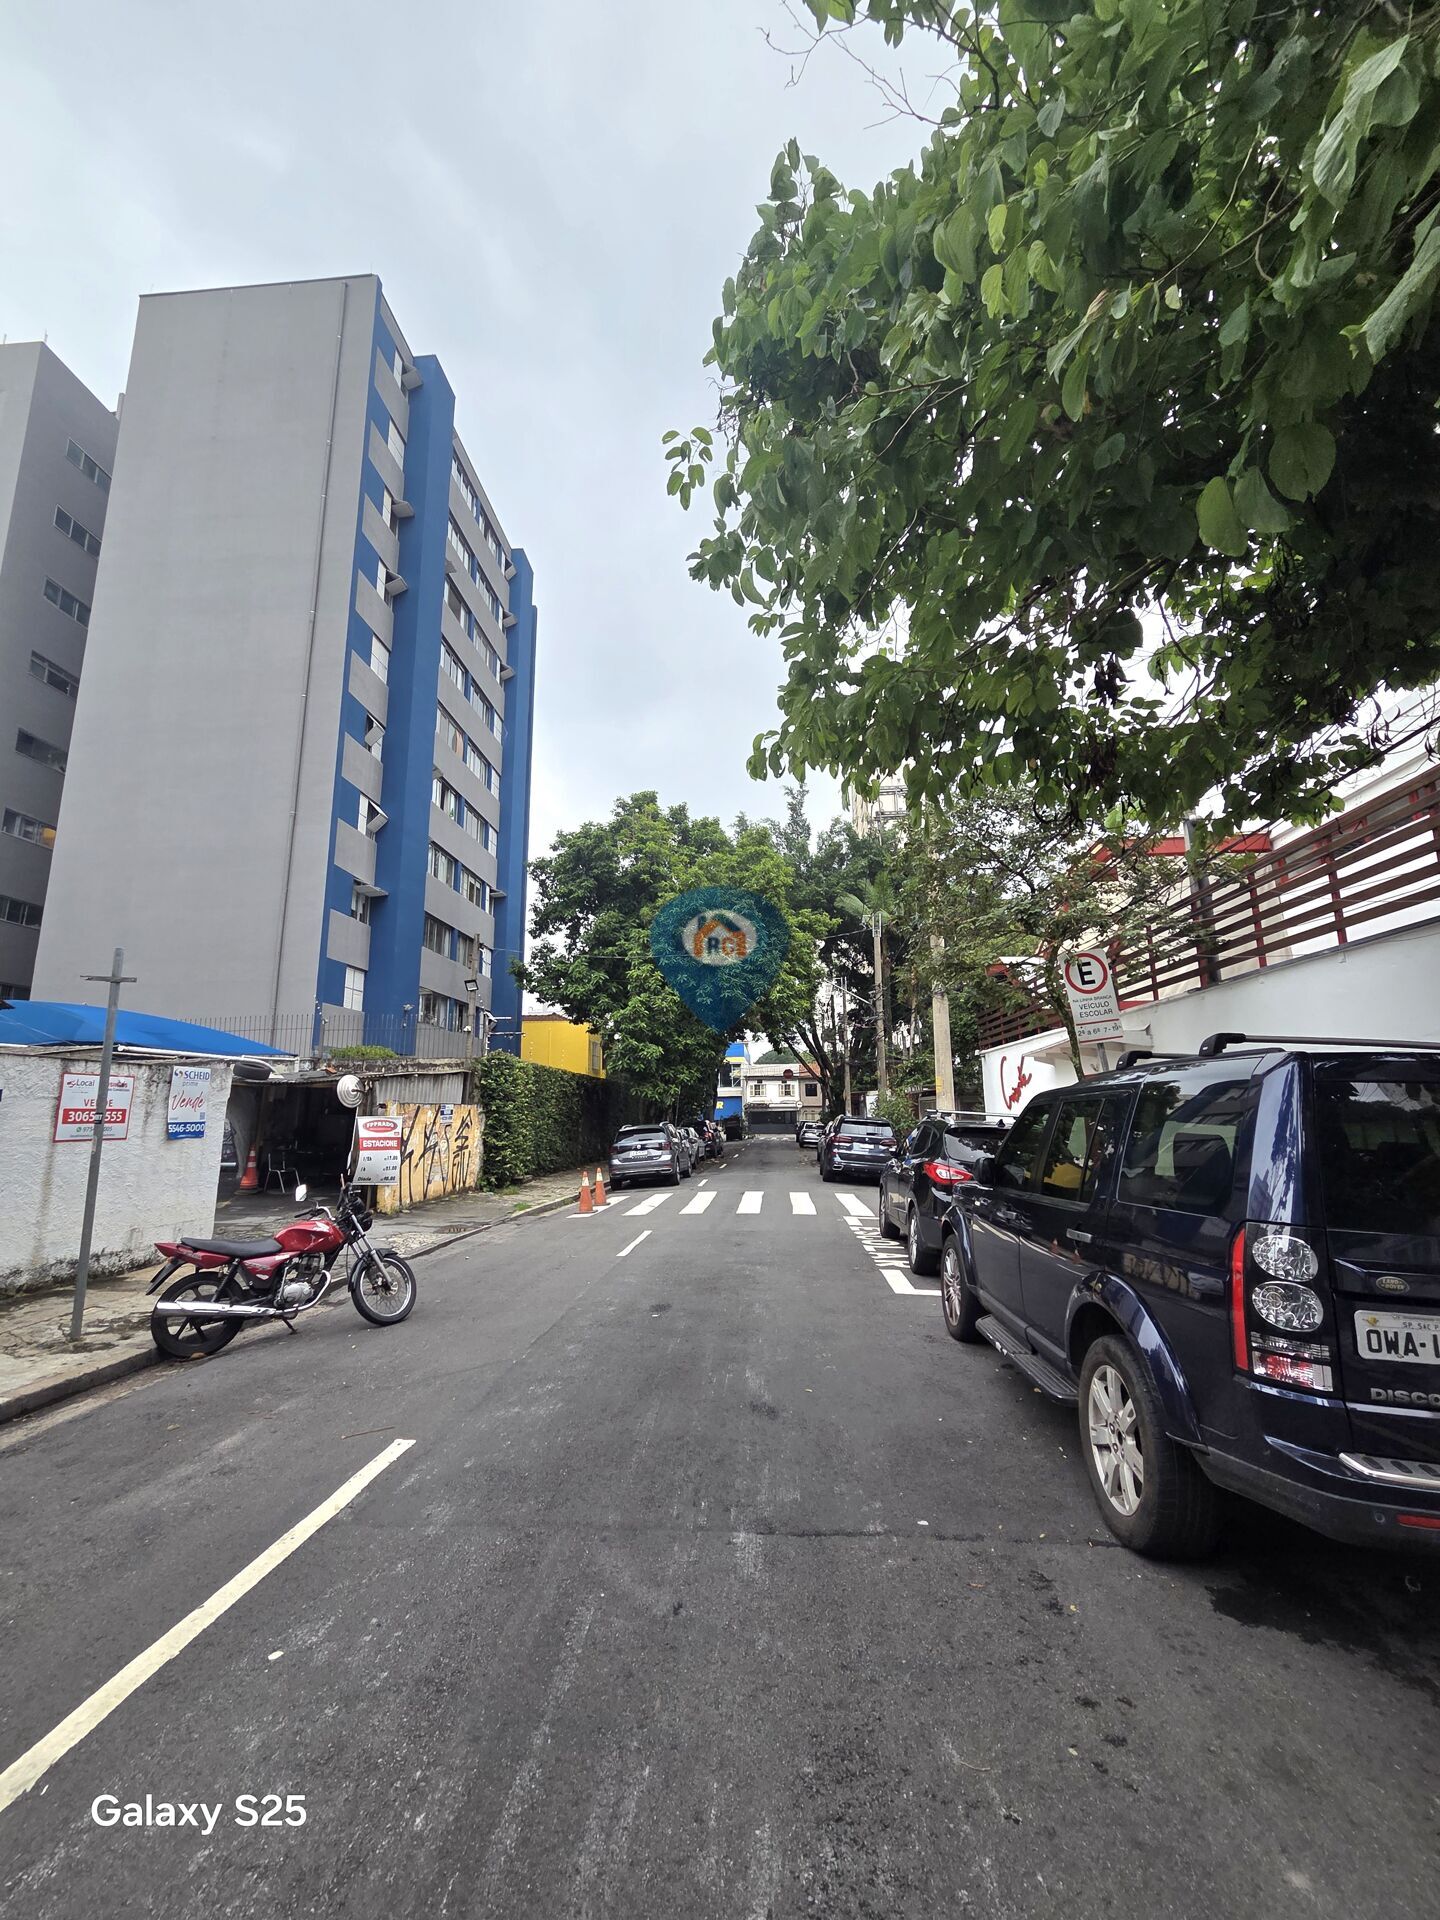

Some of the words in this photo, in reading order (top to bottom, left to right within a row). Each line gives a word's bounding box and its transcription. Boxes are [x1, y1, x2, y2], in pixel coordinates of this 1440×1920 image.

[1077, 961, 1096, 985] E
[1079, 1001, 1110, 1010] VEÍCULO
[1079, 1008, 1113, 1018] ESCOLAR
[184, 1070, 210, 1080] SCHEID
[172, 1090, 204, 1112] Vende
[362, 1140, 398, 1148] ESTACIONE
